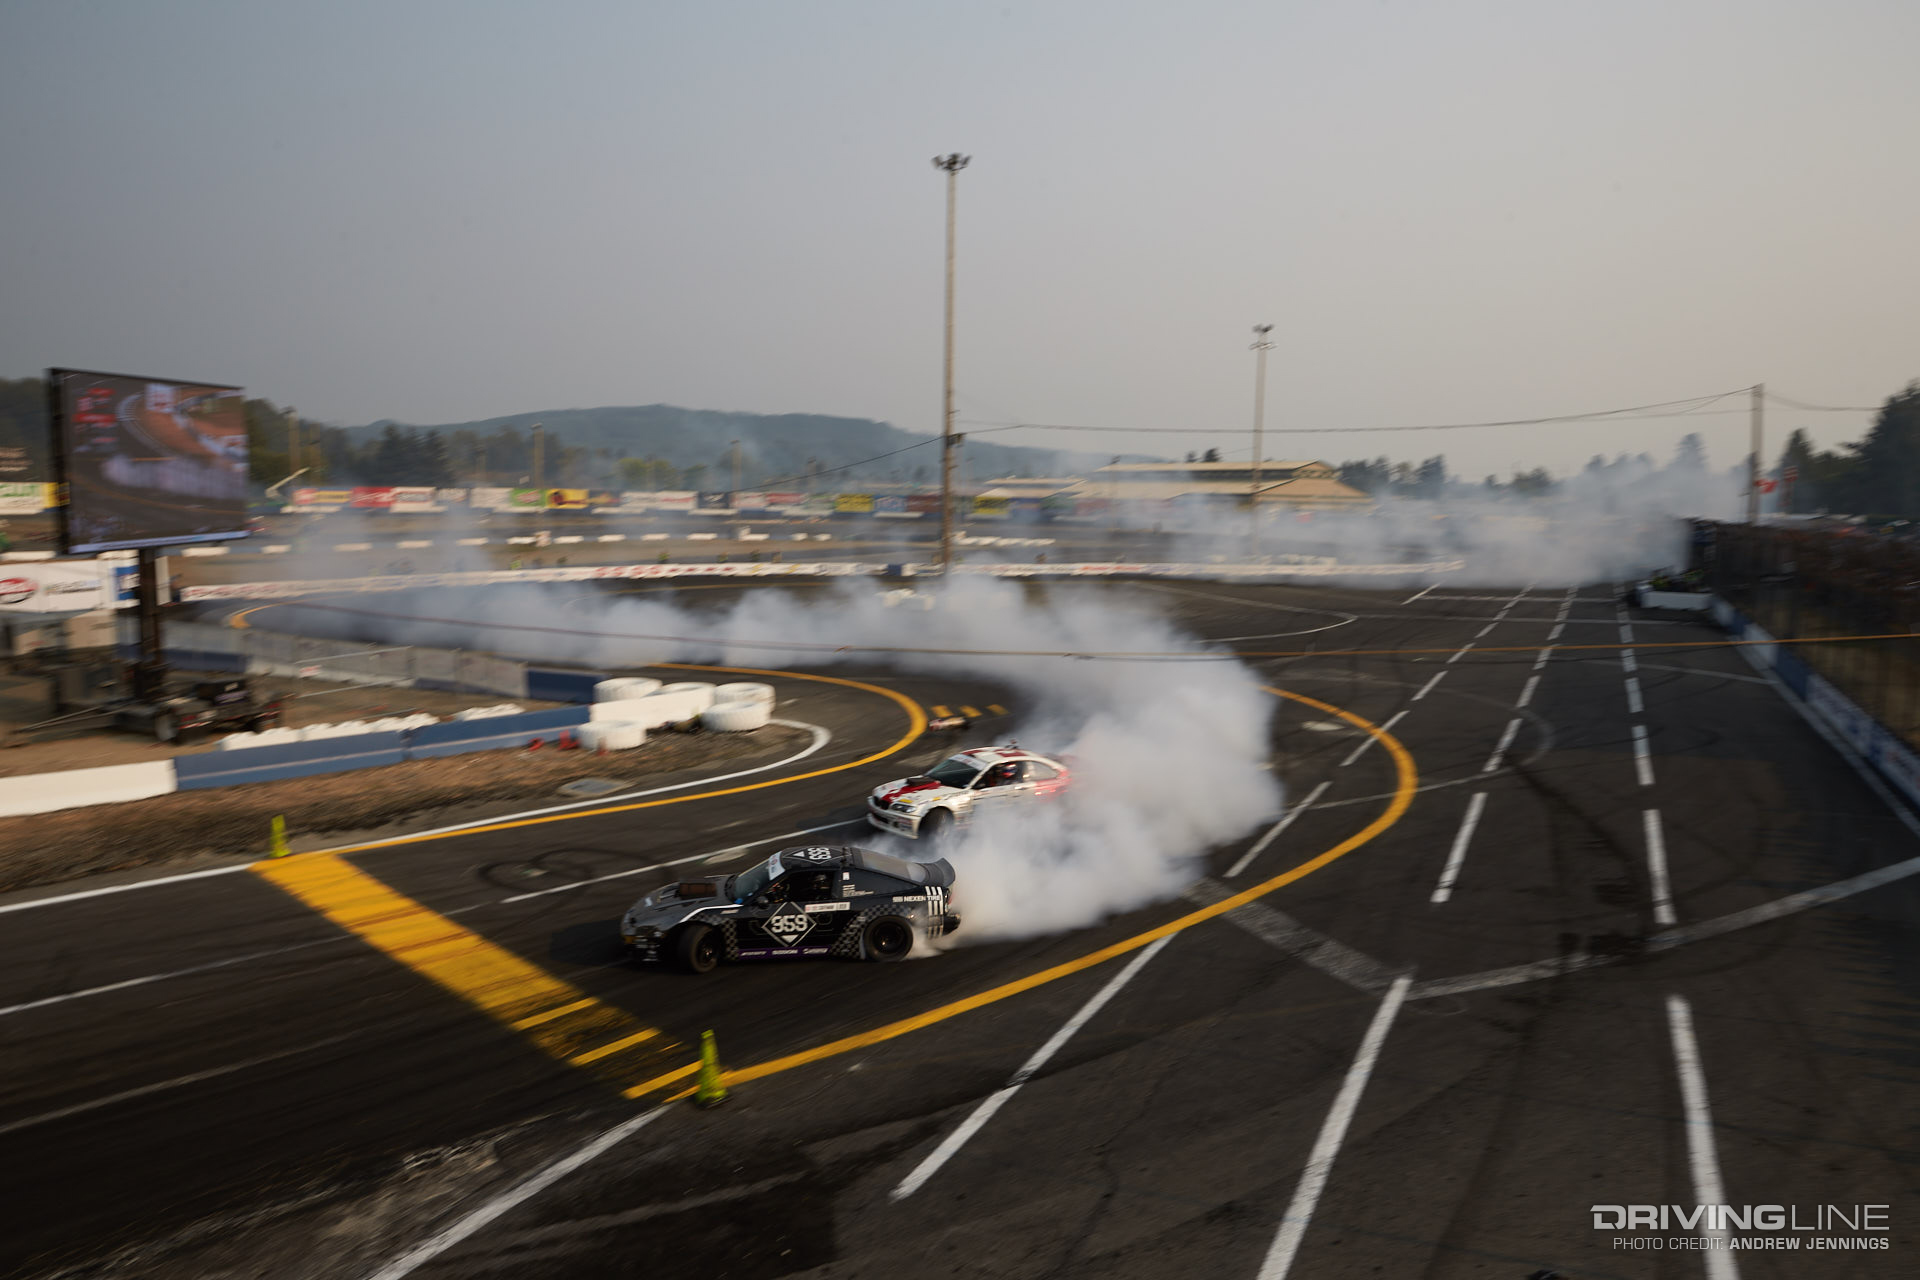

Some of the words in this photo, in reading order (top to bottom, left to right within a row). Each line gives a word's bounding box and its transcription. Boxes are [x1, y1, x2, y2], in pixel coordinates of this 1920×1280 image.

[903, 894, 926, 902] NEXEN
[927, 893, 941, 901] TIRE
[771, 914, 808, 934] 959
